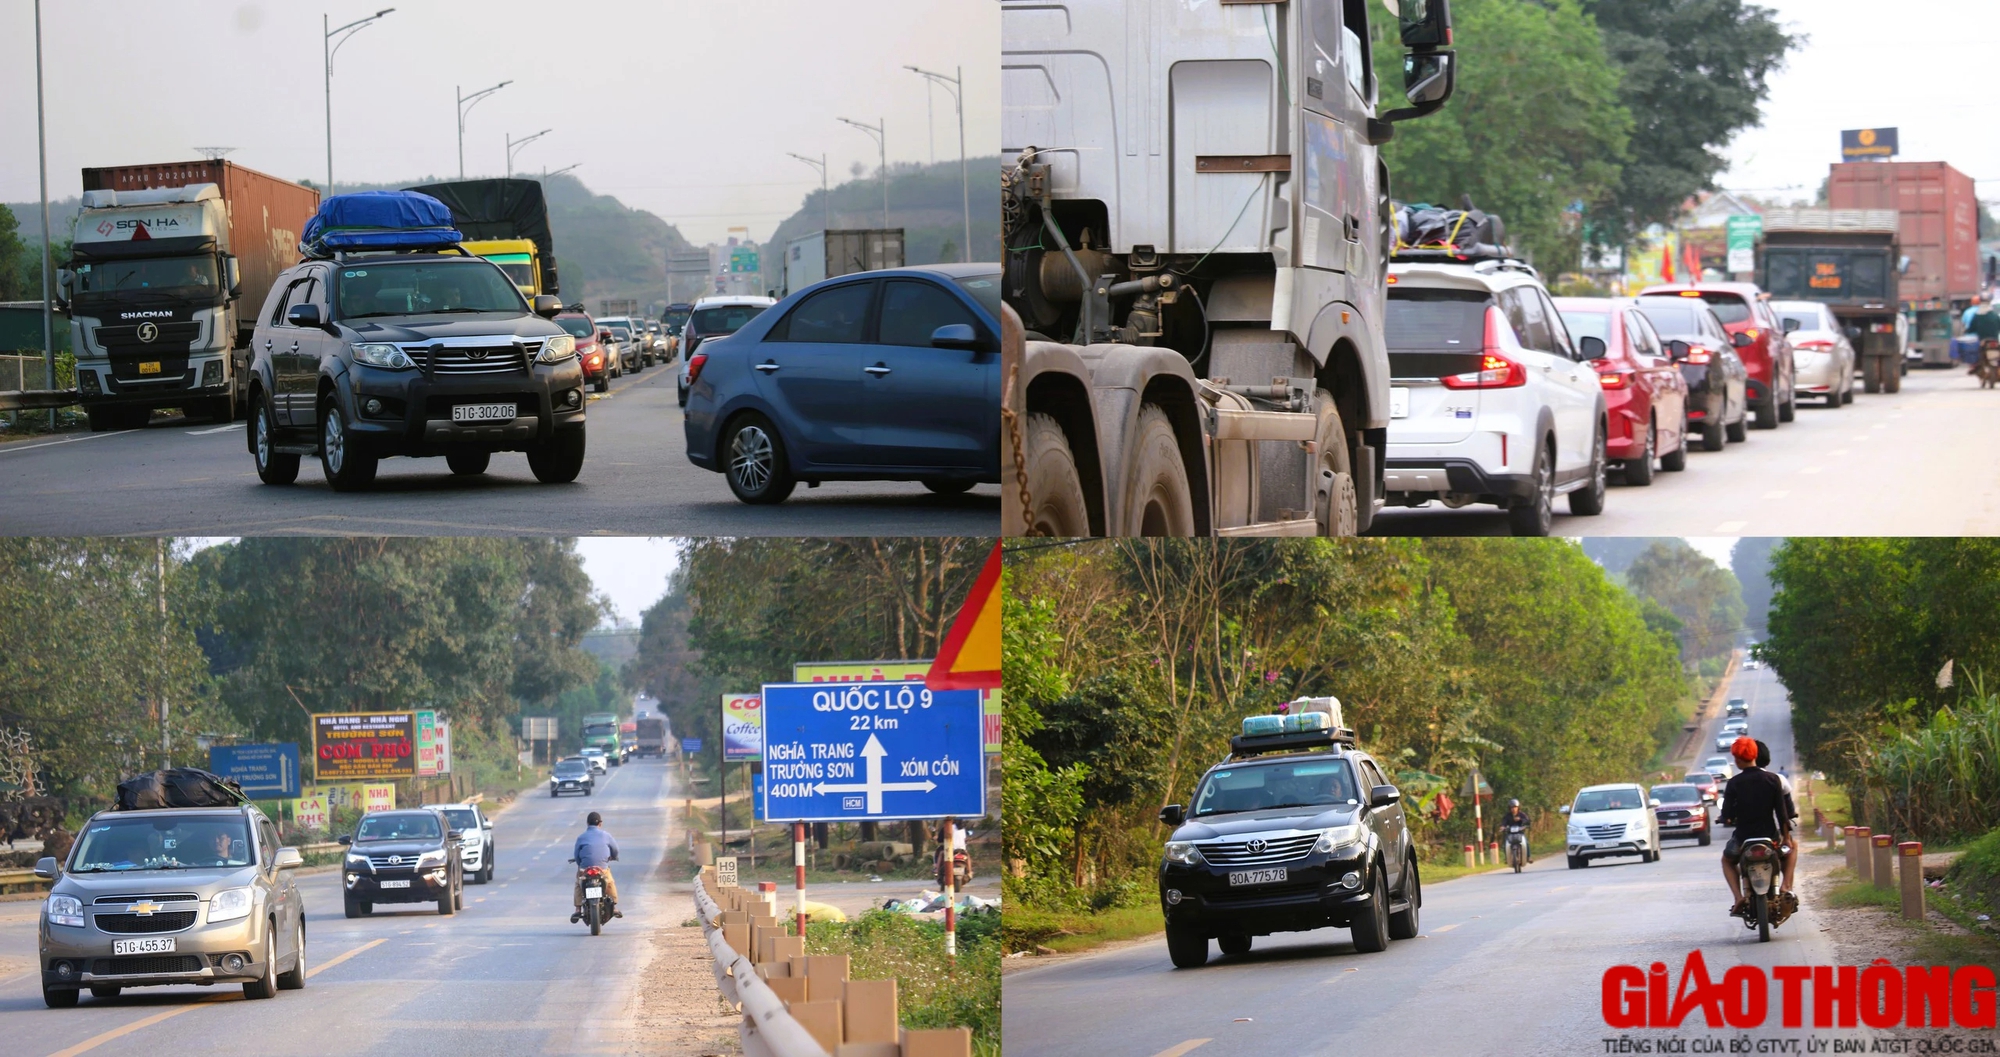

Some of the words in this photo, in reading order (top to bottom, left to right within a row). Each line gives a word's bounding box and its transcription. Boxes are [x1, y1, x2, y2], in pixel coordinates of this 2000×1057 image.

[116, 218, 151, 229] SON
[157, 218, 179, 227] HA
[120, 311, 173, 319] SHACMAN
[454, 405, 514, 420] 51G-302.06
[812, 686, 880, 712] QUỐC
[885, 685, 914, 714] LỘ
[920, 689, 933, 708] 9
[850, 715, 870, 730] 22
[874, 714, 898, 730] km
[318, 742, 362, 759] CƠM
[371, 737, 412, 758] PHỞ
[769, 740, 806, 760] NGHĨA
[811, 742, 854, 760] TRANG
[827, 763, 854, 778] SƠN
[900, 757, 928, 777] XÓM
[846, 799, 861, 807] HCM
[719, 861, 735, 871] H9
[718, 875, 736, 883] 1062
[1231, 869, 1285, 885] 30A-775.78
[116, 939, 172, 954] 51G-455.37
